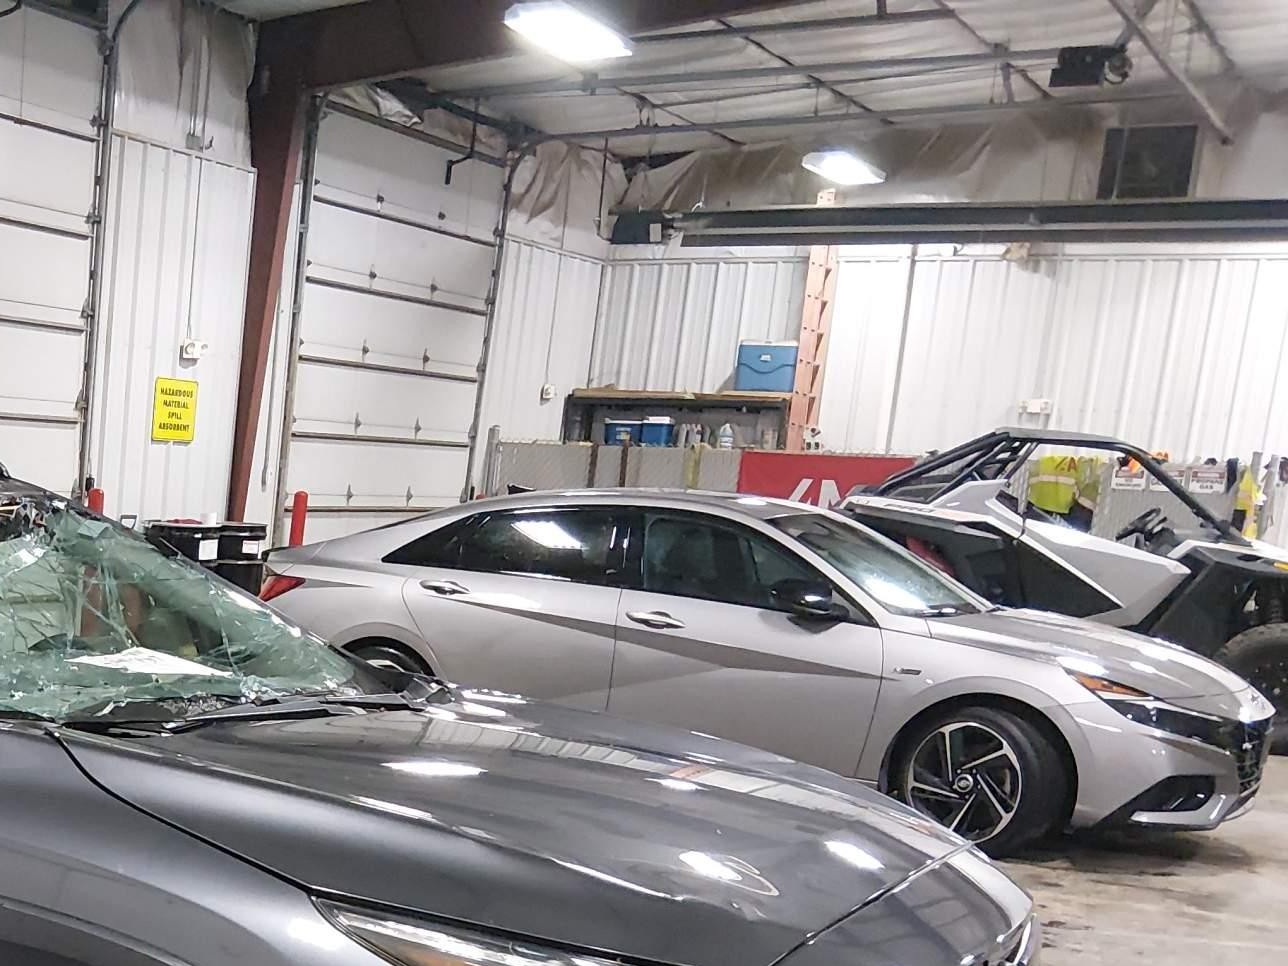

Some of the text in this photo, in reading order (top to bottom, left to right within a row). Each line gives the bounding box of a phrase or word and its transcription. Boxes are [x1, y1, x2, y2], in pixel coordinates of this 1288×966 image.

[160, 387, 193, 398] HAZARDOUS
[163, 399, 189, 409] MATERIAL
[167, 411, 182, 420] SPILL
[158, 422, 190, 432] ABSORBENT
